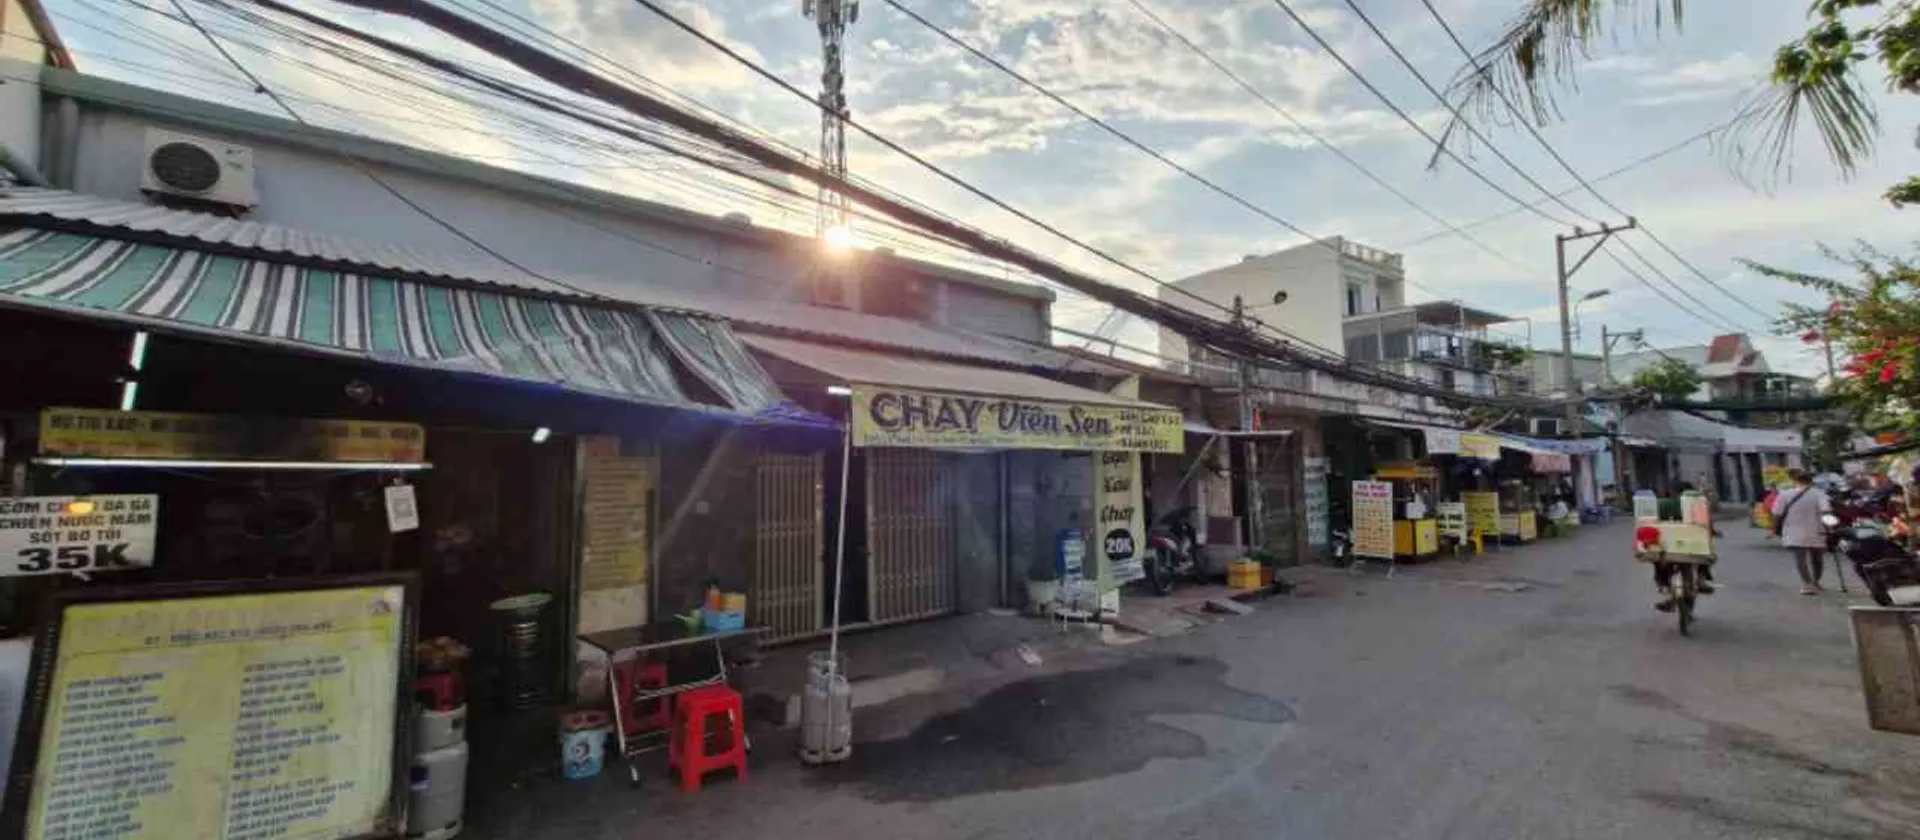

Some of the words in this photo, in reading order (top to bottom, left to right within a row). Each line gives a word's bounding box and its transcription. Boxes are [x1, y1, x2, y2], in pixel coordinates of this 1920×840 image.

[869, 391, 985, 433] CHAY
[988, 400, 1062, 433] Viên
[1065, 404, 1112, 435] Sen
[17, 542, 130, 572] 35K
